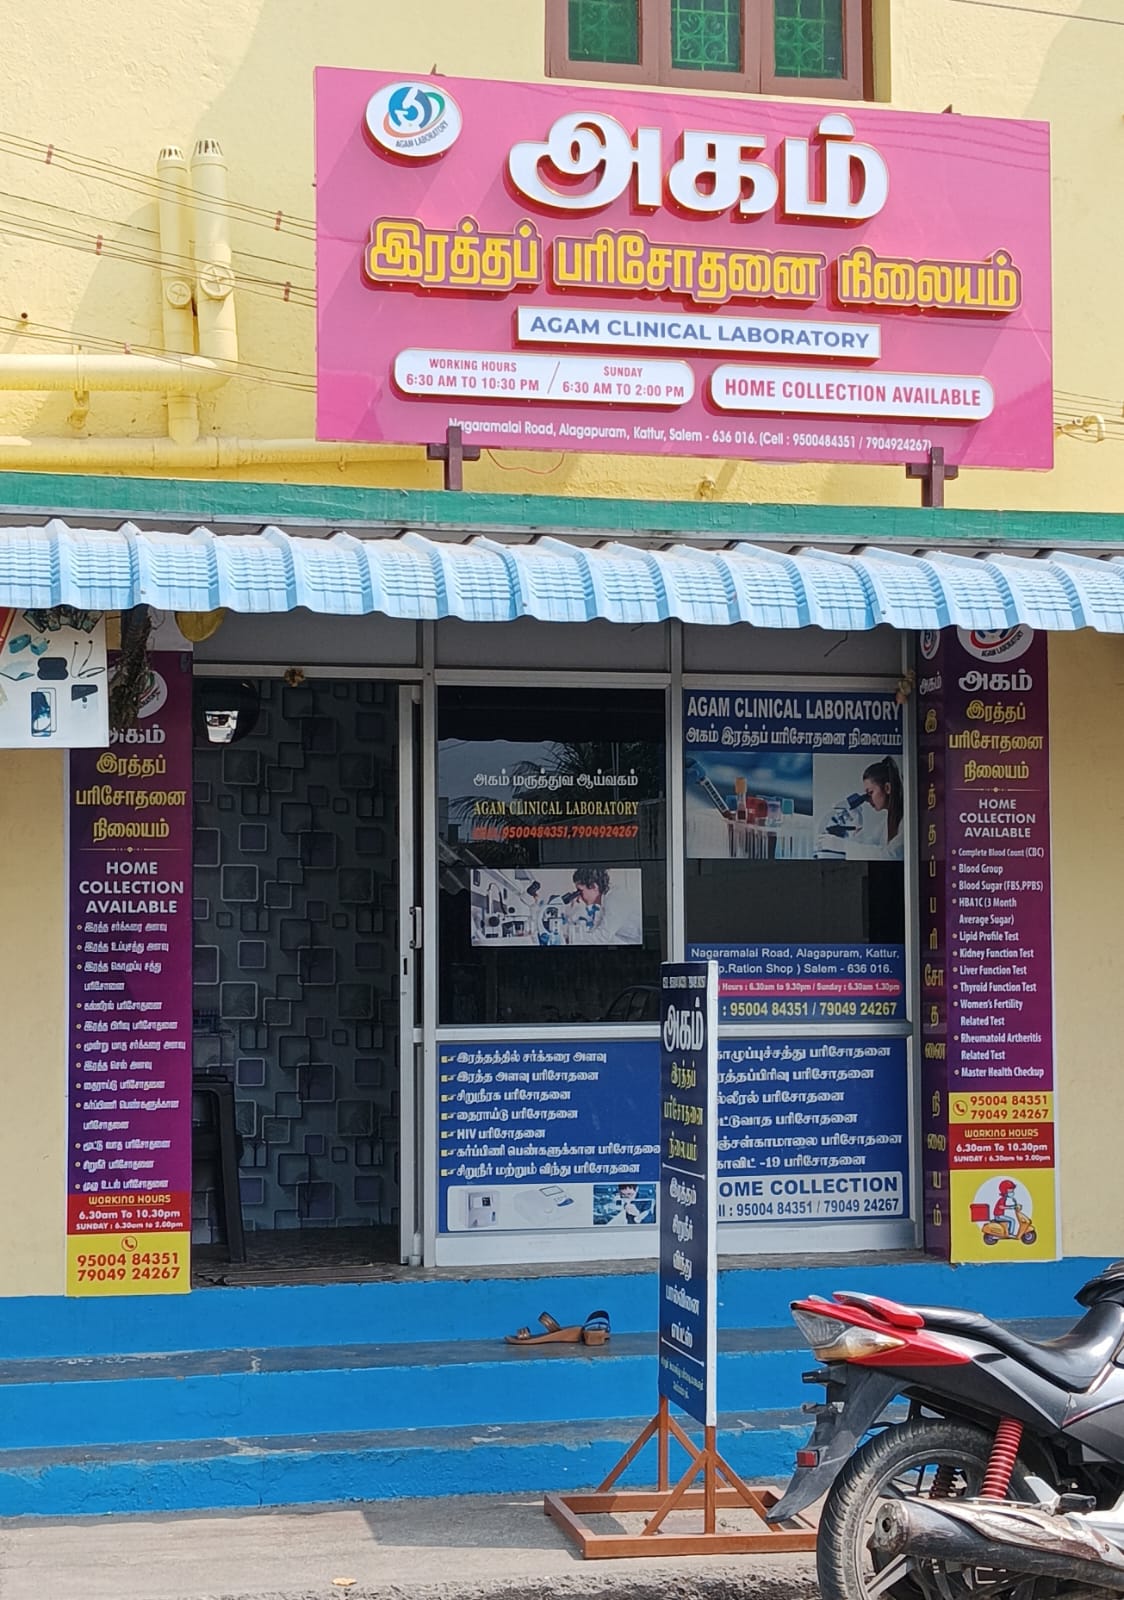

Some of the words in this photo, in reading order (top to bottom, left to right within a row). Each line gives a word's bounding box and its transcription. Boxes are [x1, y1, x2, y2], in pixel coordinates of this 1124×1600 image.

[395, 138, 414, 148] AGAM
[414, 120, 449, 147] LABORATORY
[508, 112, 889, 219] அகம்
[367, 217, 541, 289] இரத்தப்
[555, 230, 824, 302] பரிசோதனை
[840, 247, 1019, 309] நிலையம்
[530, 316, 600, 335] AGAM
[607, 318, 712, 342] CLINICAL
[717, 325, 870, 349] LABORATORY
[429, 358, 478, 371] WORKING
[481, 359, 517, 373] HOURS
[604, 365, 643, 378] SUNDAY
[406, 373, 434, 387] 6:30
[437, 374, 458, 388] AM
[461, 375, 477, 388] TO
[481, 376, 517, 390] 10:30
[520, 377, 539, 391] PM
[562, 380, 589, 394] 6:30
[593, 381, 612, 394] AM
[615, 382, 632, 395] TO
[636, 383, 662, 396] 2:00
[666, 384, 684, 398] PM
[725, 379, 775, 397] HOME
[782, 381, 887, 402] COLLECTION
[892, 386, 981, 407] AVAILABLE
[524, 420, 556, 437] Road,
[558, 423, 630, 440] Alagapuram,
[634, 426, 666, 441] Kattur,
[669, 428, 702, 441] Salem
[712, 430, 732, 443] 636
[734, 431, 757, 444] 016.
[759, 432, 784, 446] (Cell
[792, 434, 855, 448] 9500484351
[958, 668, 1033, 691] அகம்
[687, 696, 730, 718] AGAM
[734, 698, 802, 719] CLINICAL
[806, 699, 900, 720] LABORATORY
[966, 699, 1026, 724] இரத்தப்
[686, 723, 718, 742] அகம்
[721, 724, 768, 747] இரத்தப்
[771, 725, 845, 749] பரிசோதனை
[848, 727, 902, 749] நிலையம்
[949, 729, 1044, 753] பரிசோதனை
[96, 752, 166, 778] இரத்தப்
[964, 759, 1029, 783] நிலையம்
[473, 768, 510, 787] அகம்
[513, 768, 574, 790] மருத்துவ
[576, 768, 638, 789] ஆய்வகம்
[76, 785, 187, 810] பரிசோதனை
[979, 799, 1017, 810] HOME
[473, 801, 506, 815] AGAM
[509, 801, 563, 815] CLINICAL
[566, 801, 639, 815] LABORATORY
[959, 812, 1036, 824] COLLECTION
[93, 818, 170, 842] நிலையம்
[964, 827, 1031, 838] AVAILABLE
[106, 862, 158, 874] HOME
[958, 864, 979, 873] Blood
[981, 864, 1003, 875] Group
[79, 881, 184, 894] COLLECTION
[958, 881, 979, 890] Blood
[981, 881, 1003, 892] Sugar
[85, 900, 178, 913] AVAILABLE
[993, 897, 1017, 907] Month
[959, 914, 989, 926] Average
[990, 914, 1014, 927] Sugar)
[959, 931, 977, 942] Lipid
[979, 931, 1002, 941] Profile
[1004, 931, 1019, 940] Test
[691, 948, 758, 961] Nagaramalai
[762, 948, 793, 960] Road,
[796, 948, 863, 960] Alagapuram,
[865, 948, 900, 960] Kattur,
[959, 948, 985, 960] Kidney
[986, 948, 1018, 958] Function
[1019, 948, 1034, 958] Test
[766, 963, 794, 975] Shop
[804, 963, 838, 974] Salem
[847, 963, 867, 974] 636
[870, 963, 893, 974] 016.
[960, 965, 977, 974] Liver
[979, 965, 1010, 975] Function
[1012, 965, 1027, 975] Test
[960, 982, 988, 994] Thyroid
[989, 982, 1020, 992] Function
[1021, 982, 1037, 992] Test
[730, 1002, 768, 1016] 95004
[771, 1002, 808, 1016] 84351
[820, 1002, 857, 1016] 79049
[860, 1001, 897, 1015] 24267
[960, 999, 992, 1008] Women's
[994, 999, 1023, 1011] Fertility
[663, 996, 704, 1053] அகம்
[960, 1016, 989, 1026] Related
[990, 1016, 1005, 1026] Test
[810, 1044, 891, 1058] பரிசோதனை
[961, 1050, 989, 1060] Related
[990, 1050, 1005, 1060] Test
[456, 1069, 493, 1084] இரத்த
[495, 1071, 529, 1083] அளவு
[532, 1069, 599, 1083] பரிசோதனை
[793, 1067, 875, 1082] பரிசோதனை
[961, 1067, 986, 1077] Master
[988, 1067, 1012, 1076] Health
[1014, 1067, 1044, 1078] Checkup
[504, 1089, 571, 1102] பரிசோதனை
[762, 1089, 844, 1104] பரிசோதனை
[970, 1095, 1007, 1105] 95004
[1011, 1095, 1047, 1105] 84351
[511, 1107, 578, 1121] பரிசோதனை
[776, 1111, 858, 1126] பரிசோதனை
[970, 1109, 1007, 1119] 79049
[1012, 1109, 1048, 1119] 24267
[456, 1128, 476, 1139] HIV
[478, 1127, 545, 1140] பரிசோதனை
[821, 1132, 902, 1147] பரிசோதனை
[964, 1129, 1006, 1138] WORKING
[1008, 1129, 1039, 1137] HOURS
[573, 1161, 640, 1175] பரிசோதனை
[784, 1154, 866, 1169] பரிசோதனை
[719, 1180, 763, 1197] OME
[770, 1176, 898, 1195] COLLECTION
[88, 1195, 135, 1205] WORKING
[137, 1194, 171, 1204] HOURS
[79, 1210, 118, 1219] 6.30am
[121, 1210, 132, 1218] To
[136, 1209, 180, 1219] 10.30pm
[736, 1202, 773, 1217] 95004
[777, 1201, 813, 1216] 84351
[823, 1199, 860, 1214] 79049
[864, 1198, 899, 1212] 24267
[77, 1254, 126, 1267] 95004
[132, 1252, 178, 1265] 84351
[77, 1268, 126, 1281] 79049
[132, 1267, 180, 1280] 24267
